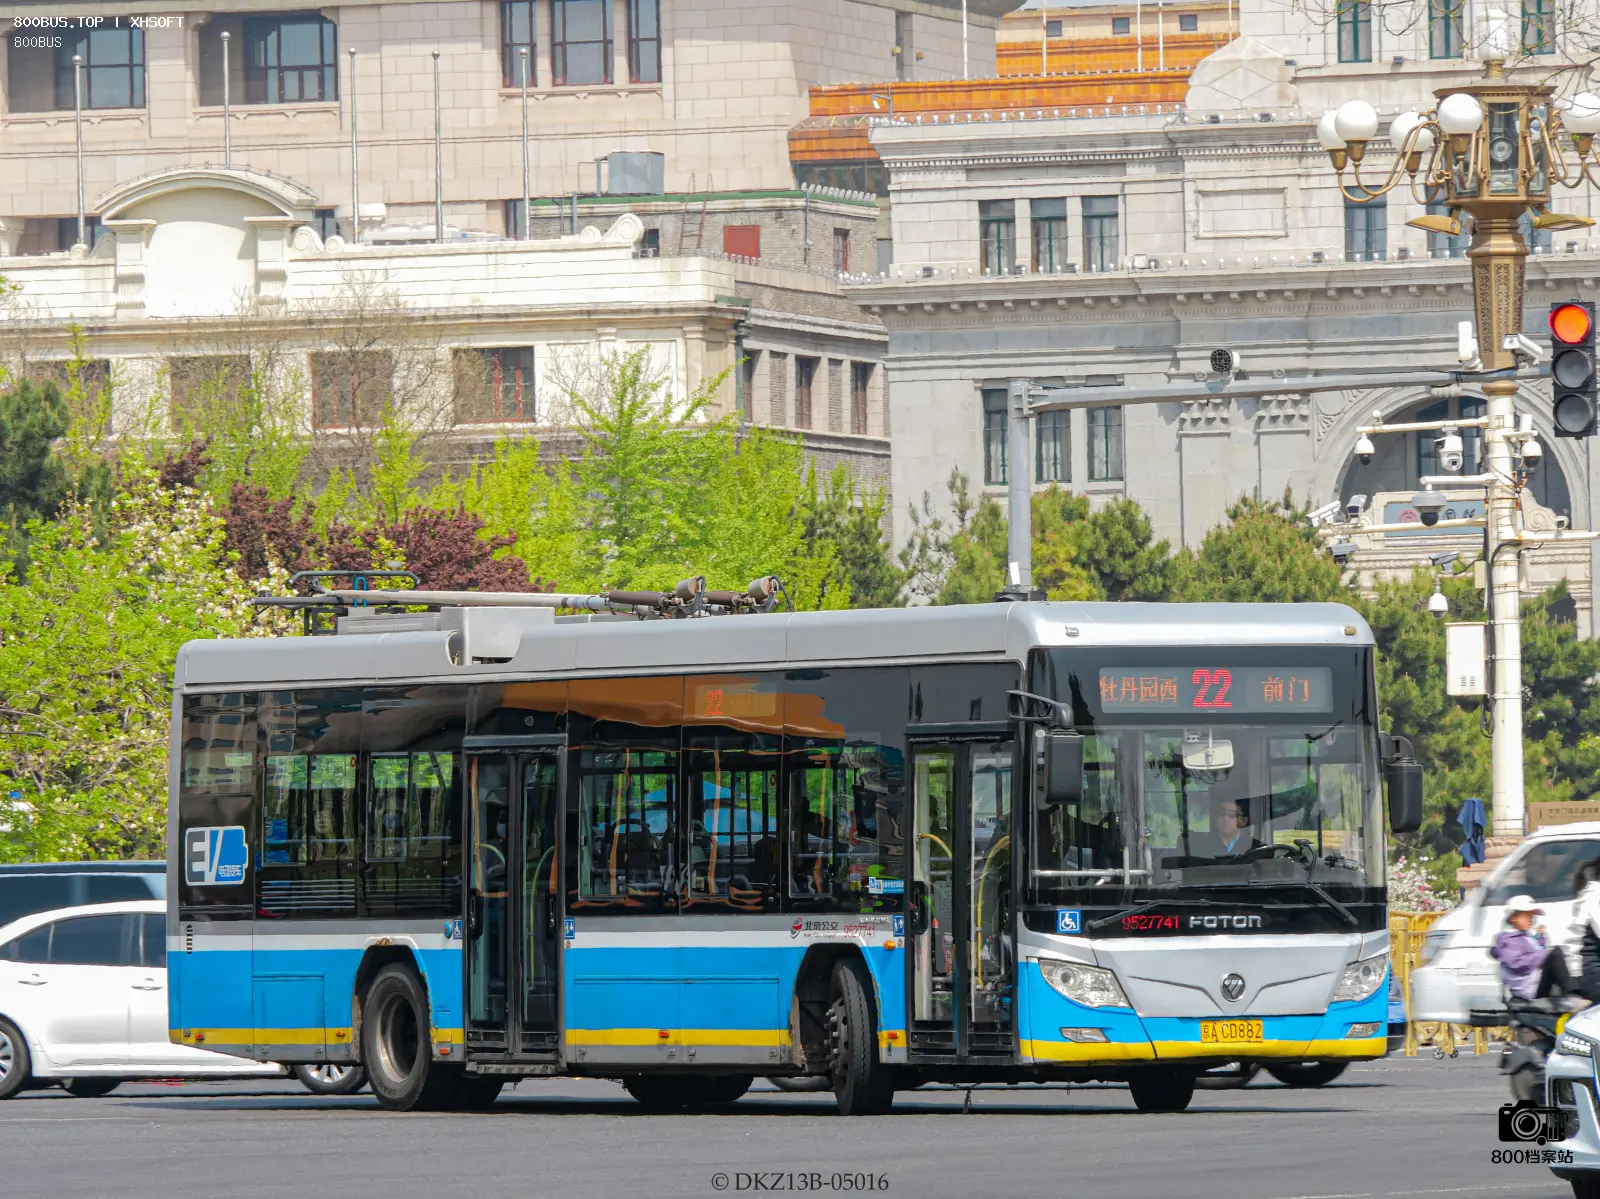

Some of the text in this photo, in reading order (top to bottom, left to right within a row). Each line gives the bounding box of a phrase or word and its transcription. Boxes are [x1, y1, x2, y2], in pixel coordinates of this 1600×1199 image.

[1099, 676, 1178, 703] 牡丹园西
[1192, 668, 1232, 708] 22
[1262, 676, 1310, 703] 前门
[804, 920, 840, 931] 北京公交
[1121, 915, 1180, 930] 9527741
[1189, 915, 1262, 929] FOTON
